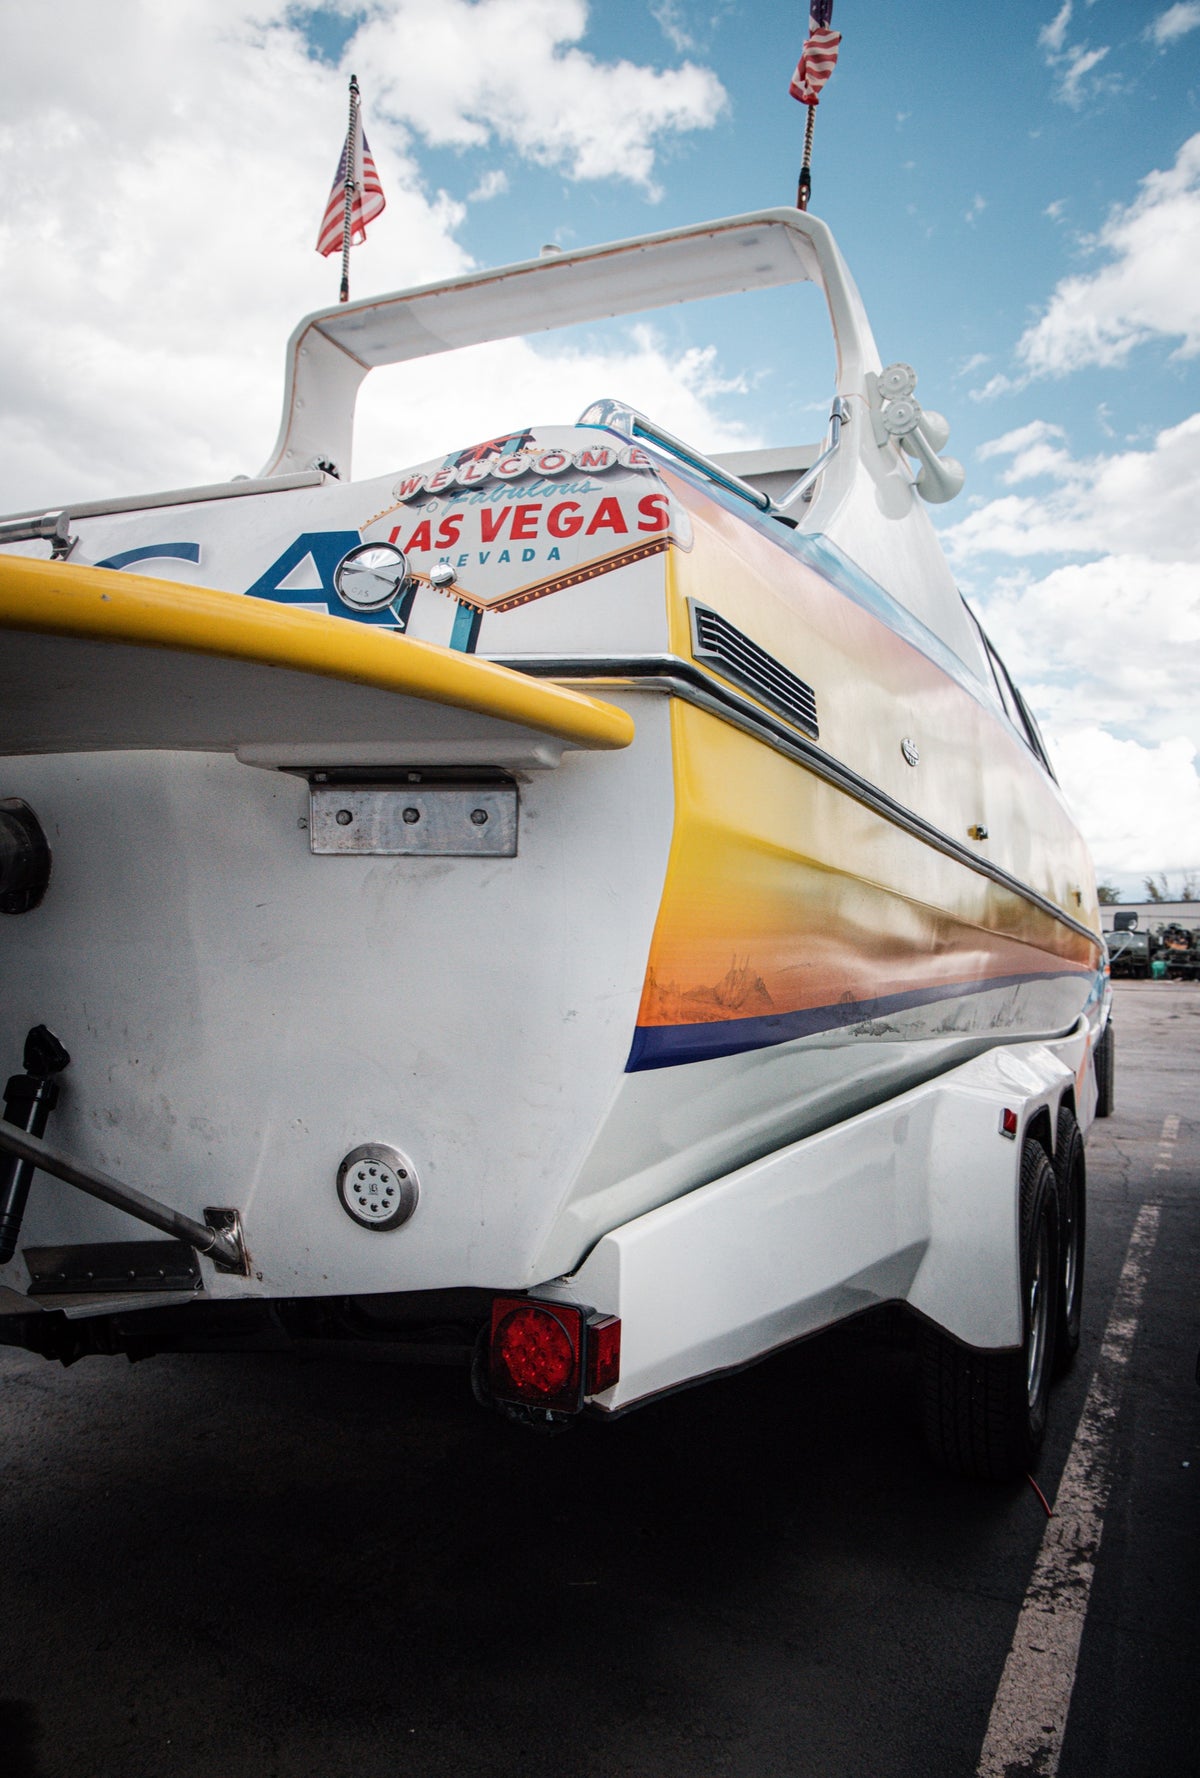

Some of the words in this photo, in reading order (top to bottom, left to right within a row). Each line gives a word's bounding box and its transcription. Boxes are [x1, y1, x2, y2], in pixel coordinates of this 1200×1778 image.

[398, 448, 651, 497] WELCOME
[416, 501, 439, 516] TO
[480, 493, 670, 543] VEGAS
